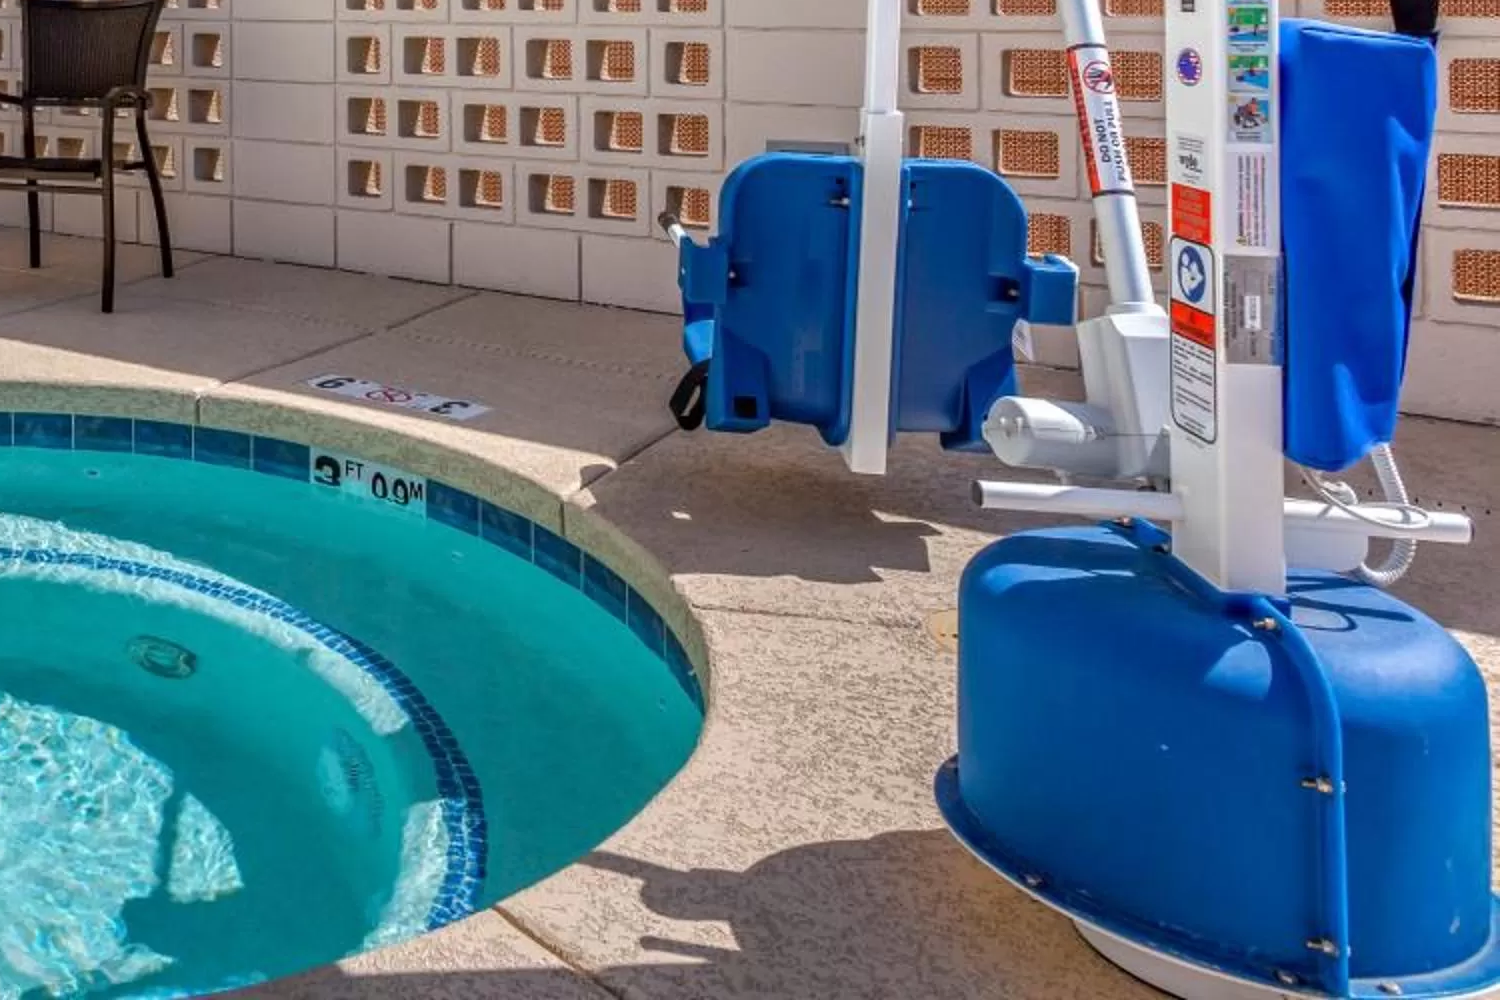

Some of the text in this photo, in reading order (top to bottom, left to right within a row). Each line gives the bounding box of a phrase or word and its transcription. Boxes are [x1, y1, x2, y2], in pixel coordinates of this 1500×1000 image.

[1094, 119, 1111, 163] DO NOT
[314, 455, 341, 487] 3
[345, 460, 365, 480] FT
